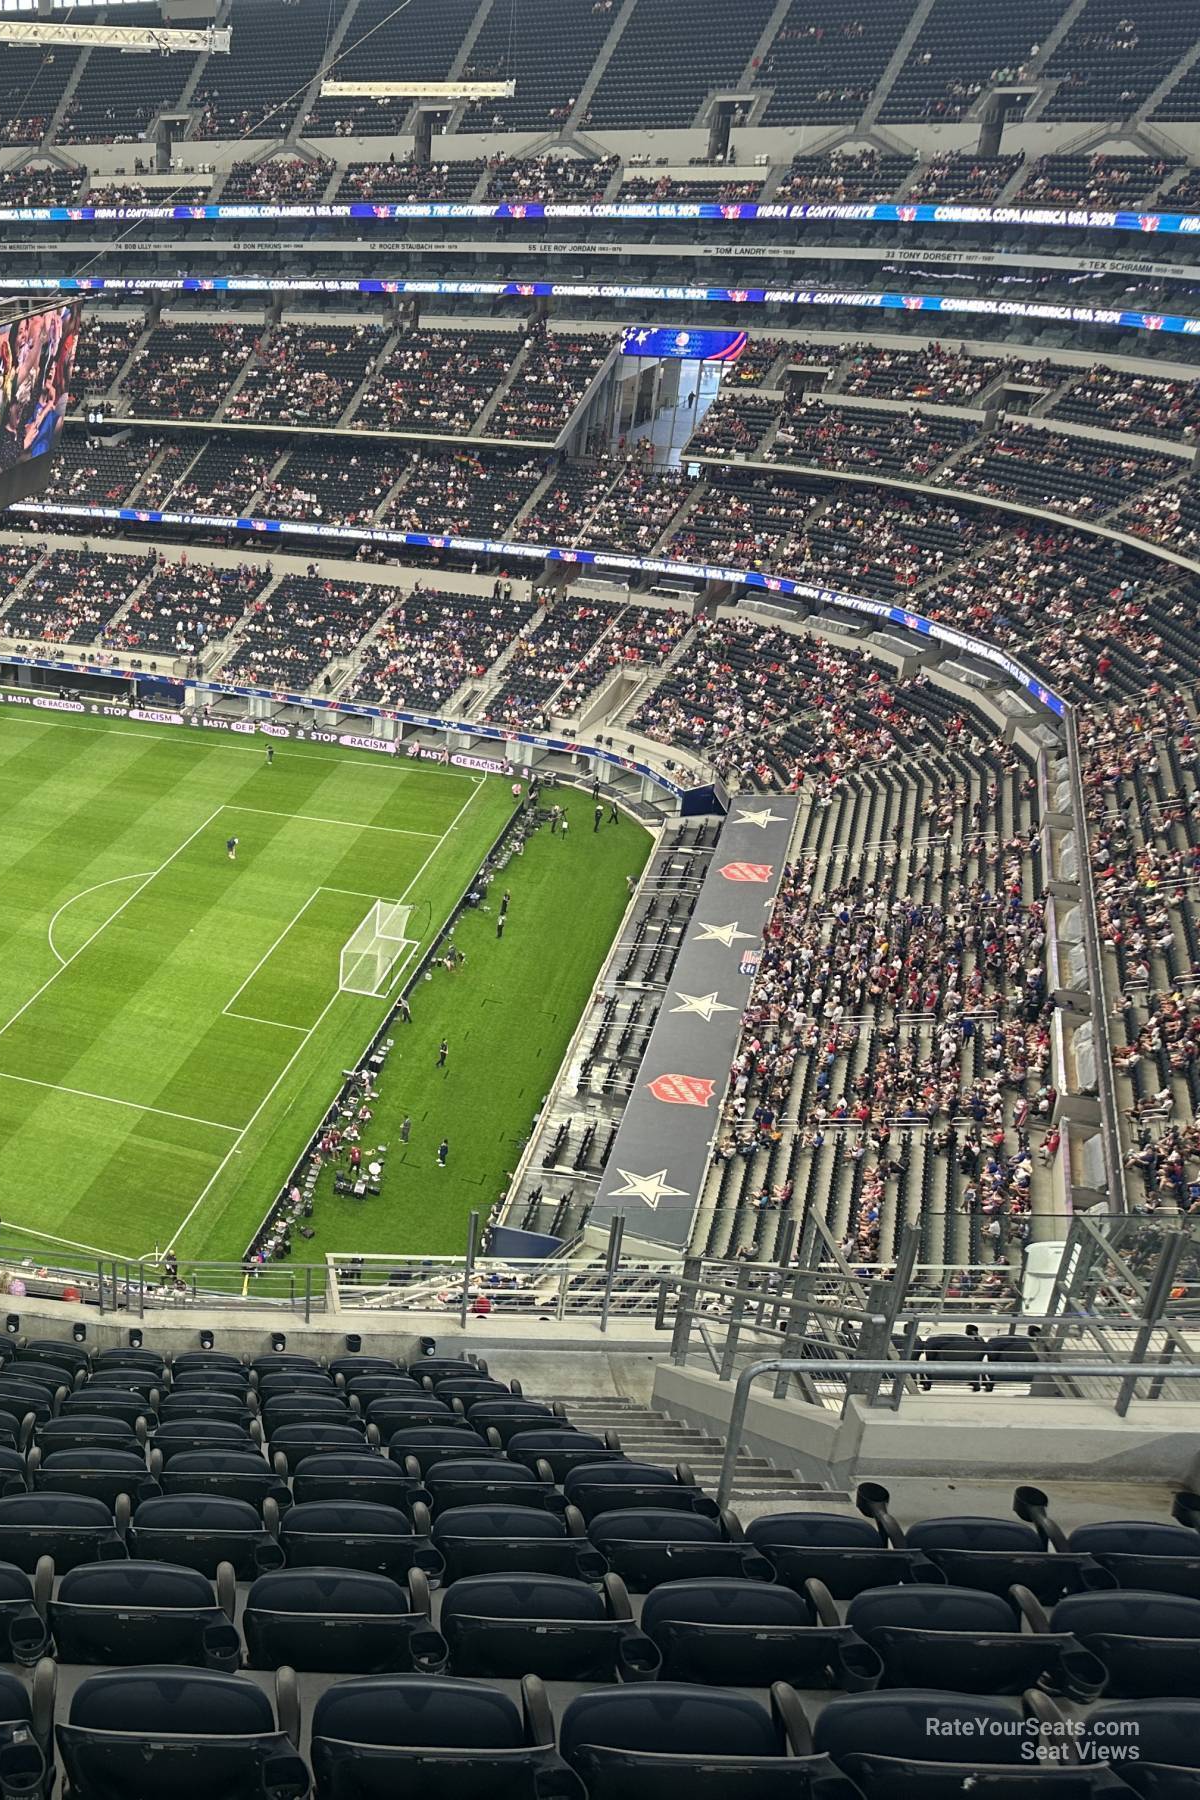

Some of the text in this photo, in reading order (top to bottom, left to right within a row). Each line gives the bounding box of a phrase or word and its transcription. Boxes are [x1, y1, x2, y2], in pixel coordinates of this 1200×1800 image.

[756, 206, 876, 217] VIBRA EL CONTINENTE
[934, 208, 1117, 226] CONMEBOL COPA AMERICA USA 2024
[923, 253, 963, 261] DORSETT
[1089, 261, 1106, 269] TEX
[1109, 262, 1153, 272] SCHRAMM
[764, 291, 881, 305] VIBRA EL CONTINENTE
[940, 299, 1120, 323] CONMEBOL COPA AMERICA USA 2024
[8, 695, 30, 704] BASTA
[48, 700, 81, 710] RACISMO
[103, 707, 172, 721] STOP RACISM
[203, 720, 228, 729] BASTA
[311, 732, 387, 750] STOP RACISM
[421, 750, 501, 771] BAST DE RACISM
